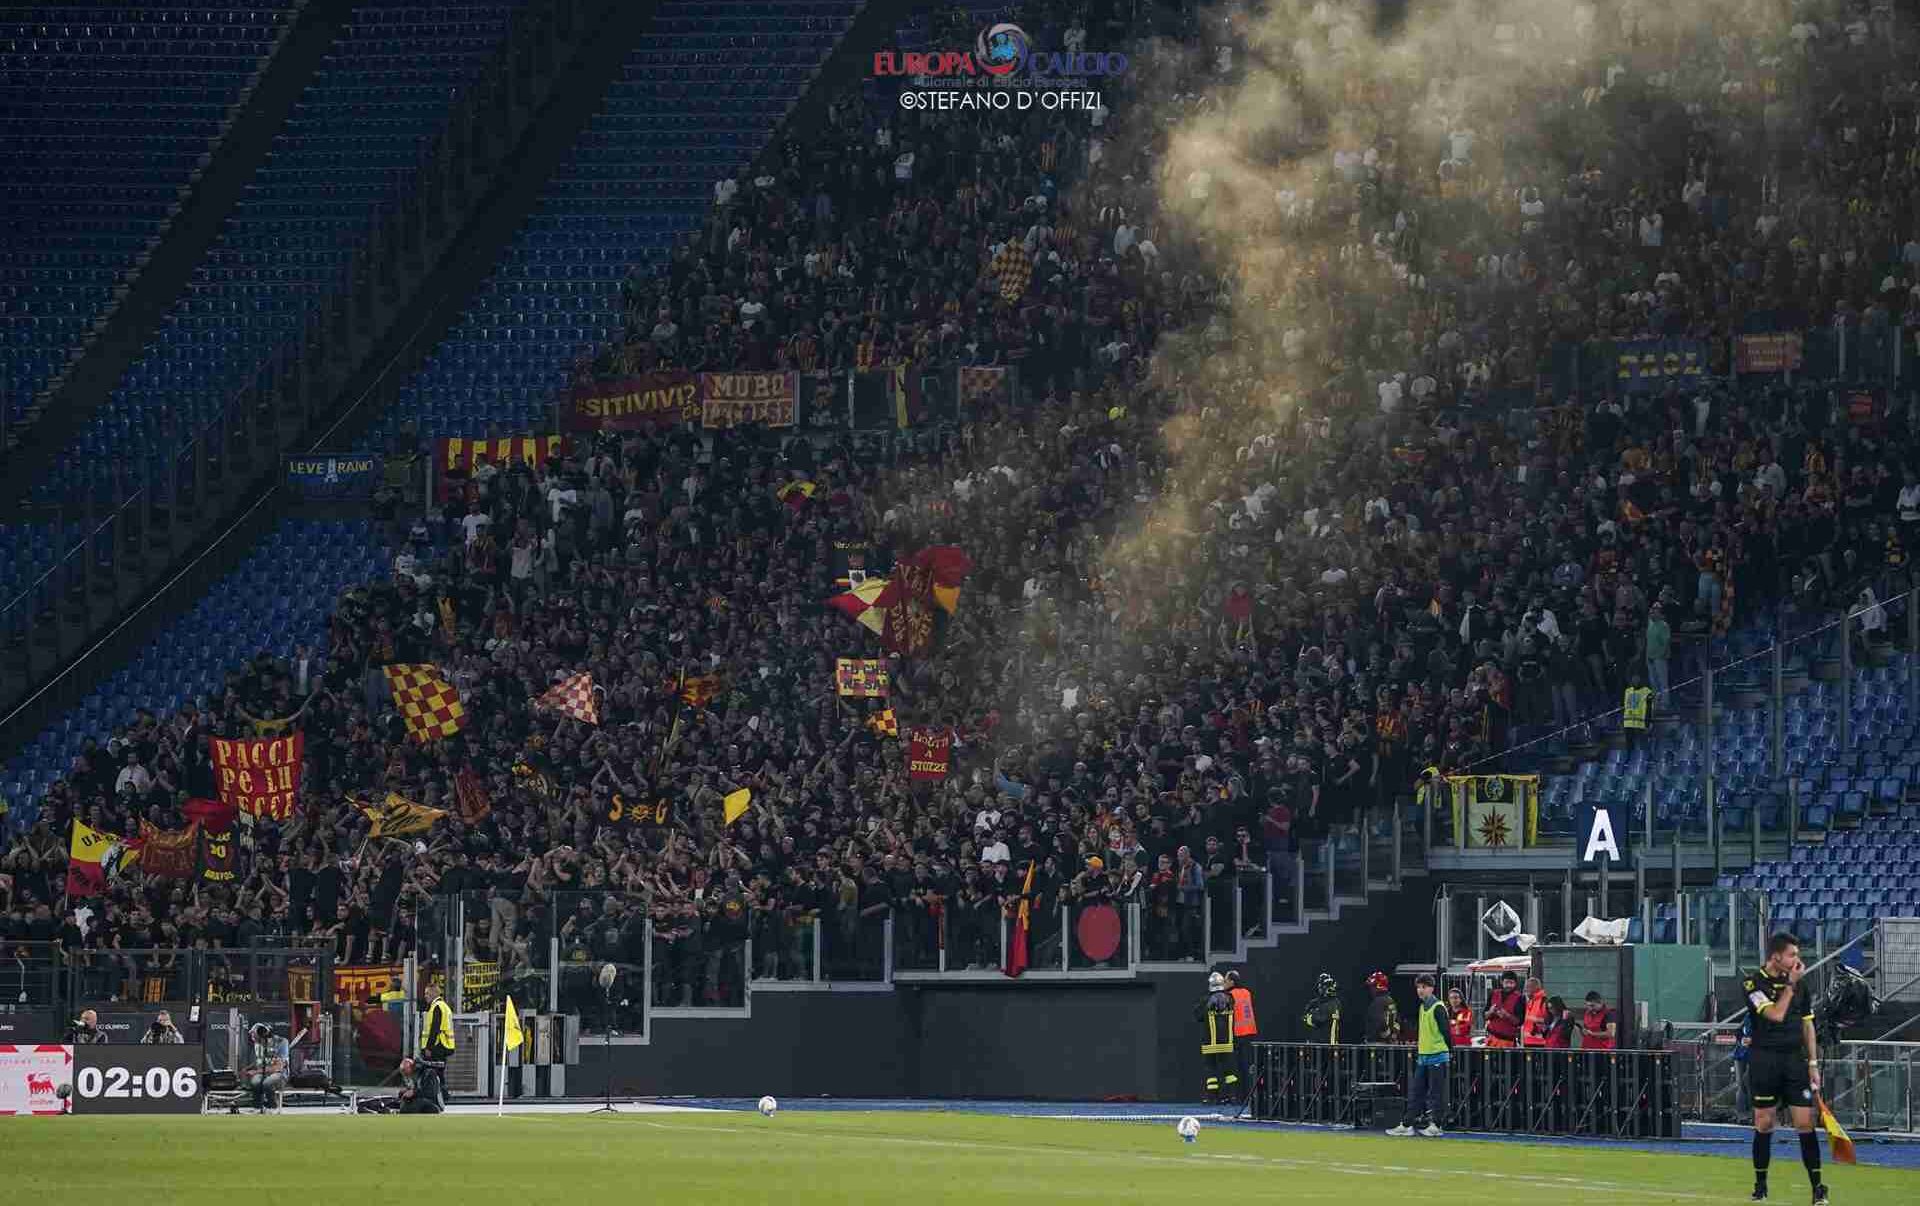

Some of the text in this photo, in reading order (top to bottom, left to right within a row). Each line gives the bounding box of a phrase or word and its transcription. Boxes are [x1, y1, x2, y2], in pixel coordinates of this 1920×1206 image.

[712, 374, 785, 397] MURO
[216, 736, 297, 768] PACCI
[1583, 809, 1621, 862] A
[77, 1066, 198, 1098] 02:06
